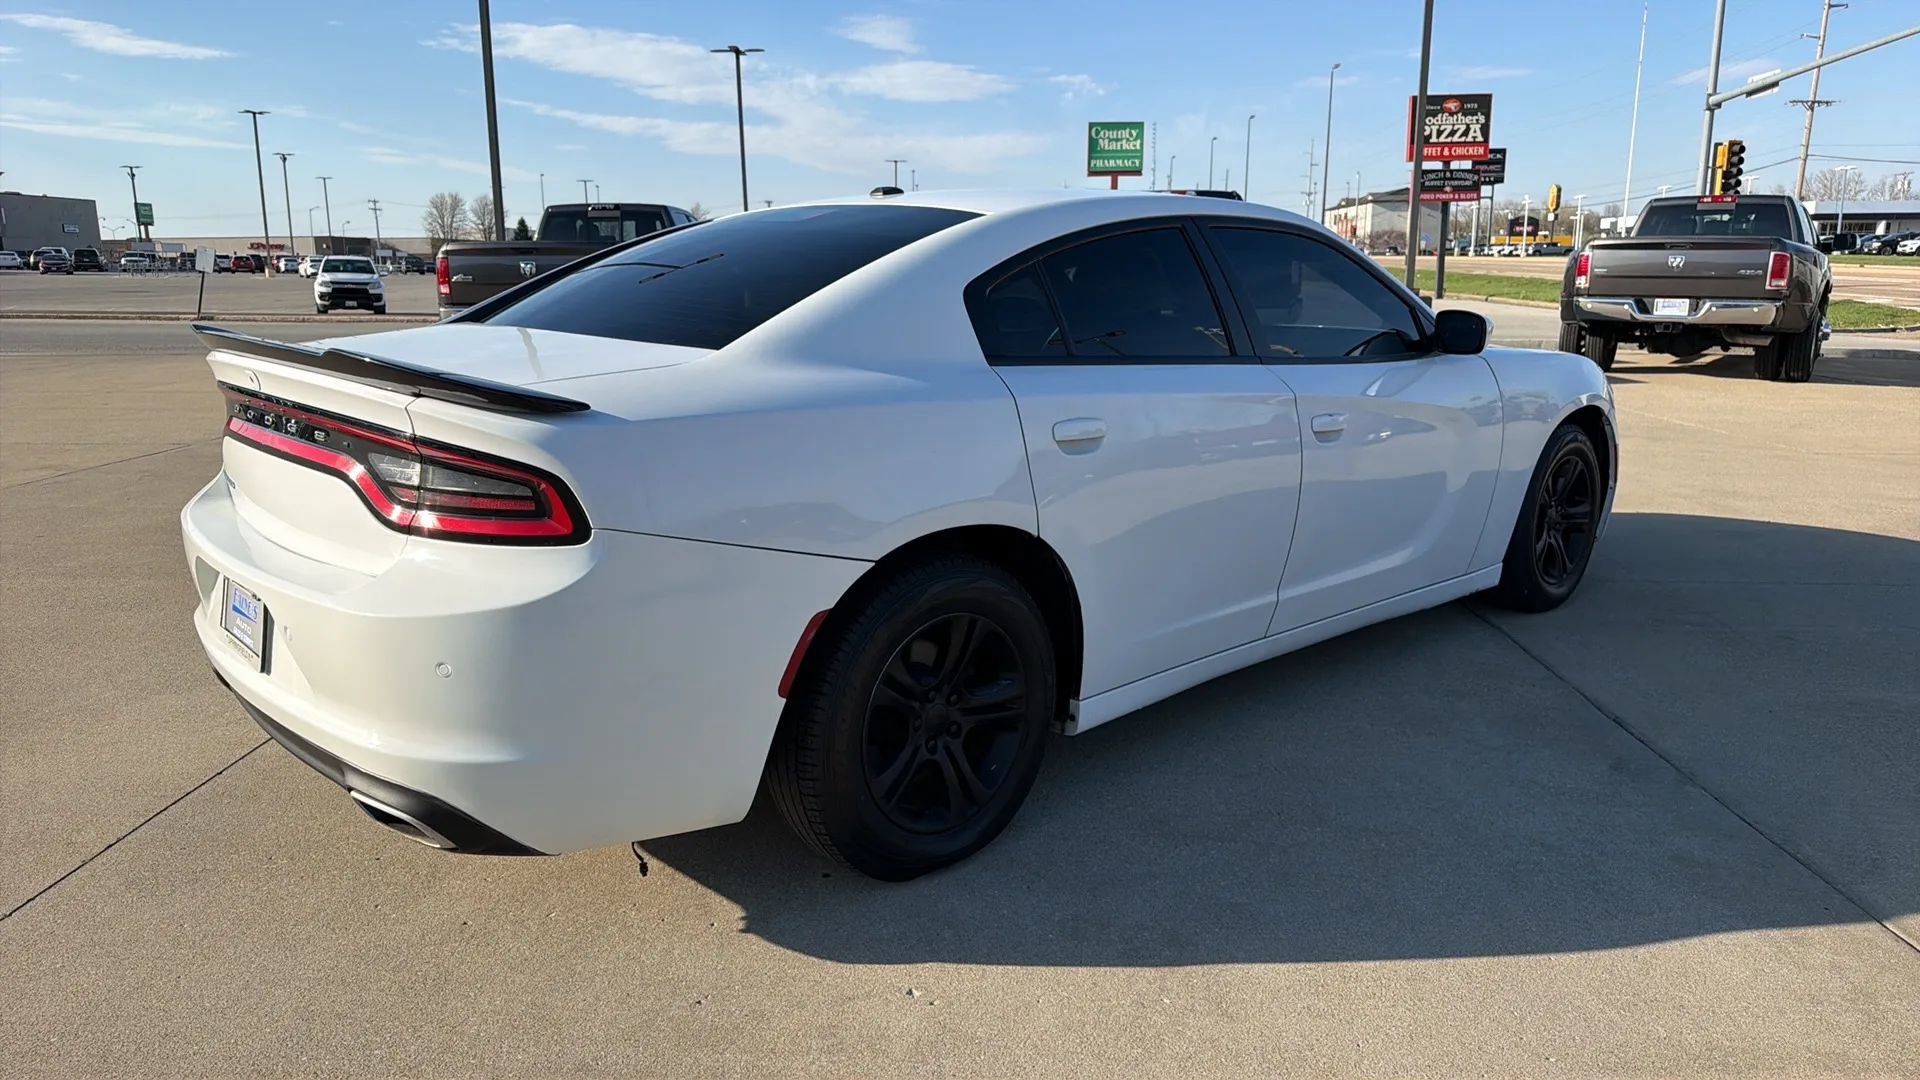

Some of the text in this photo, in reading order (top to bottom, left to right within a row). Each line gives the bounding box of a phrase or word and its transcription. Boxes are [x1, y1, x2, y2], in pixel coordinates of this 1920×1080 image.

[1425, 112, 1485, 125] odfather's
[1091, 127, 1139, 140] County
[1097, 139, 1141, 151] Market
[1424, 146, 1484, 156] FFET & CHICKEN
[1090, 159, 1140, 167] PHARMACY
[1452, 171, 1479, 181] DINNER
[233, 404, 326, 442] DODGE
[235, 617, 252, 635] AUTO
